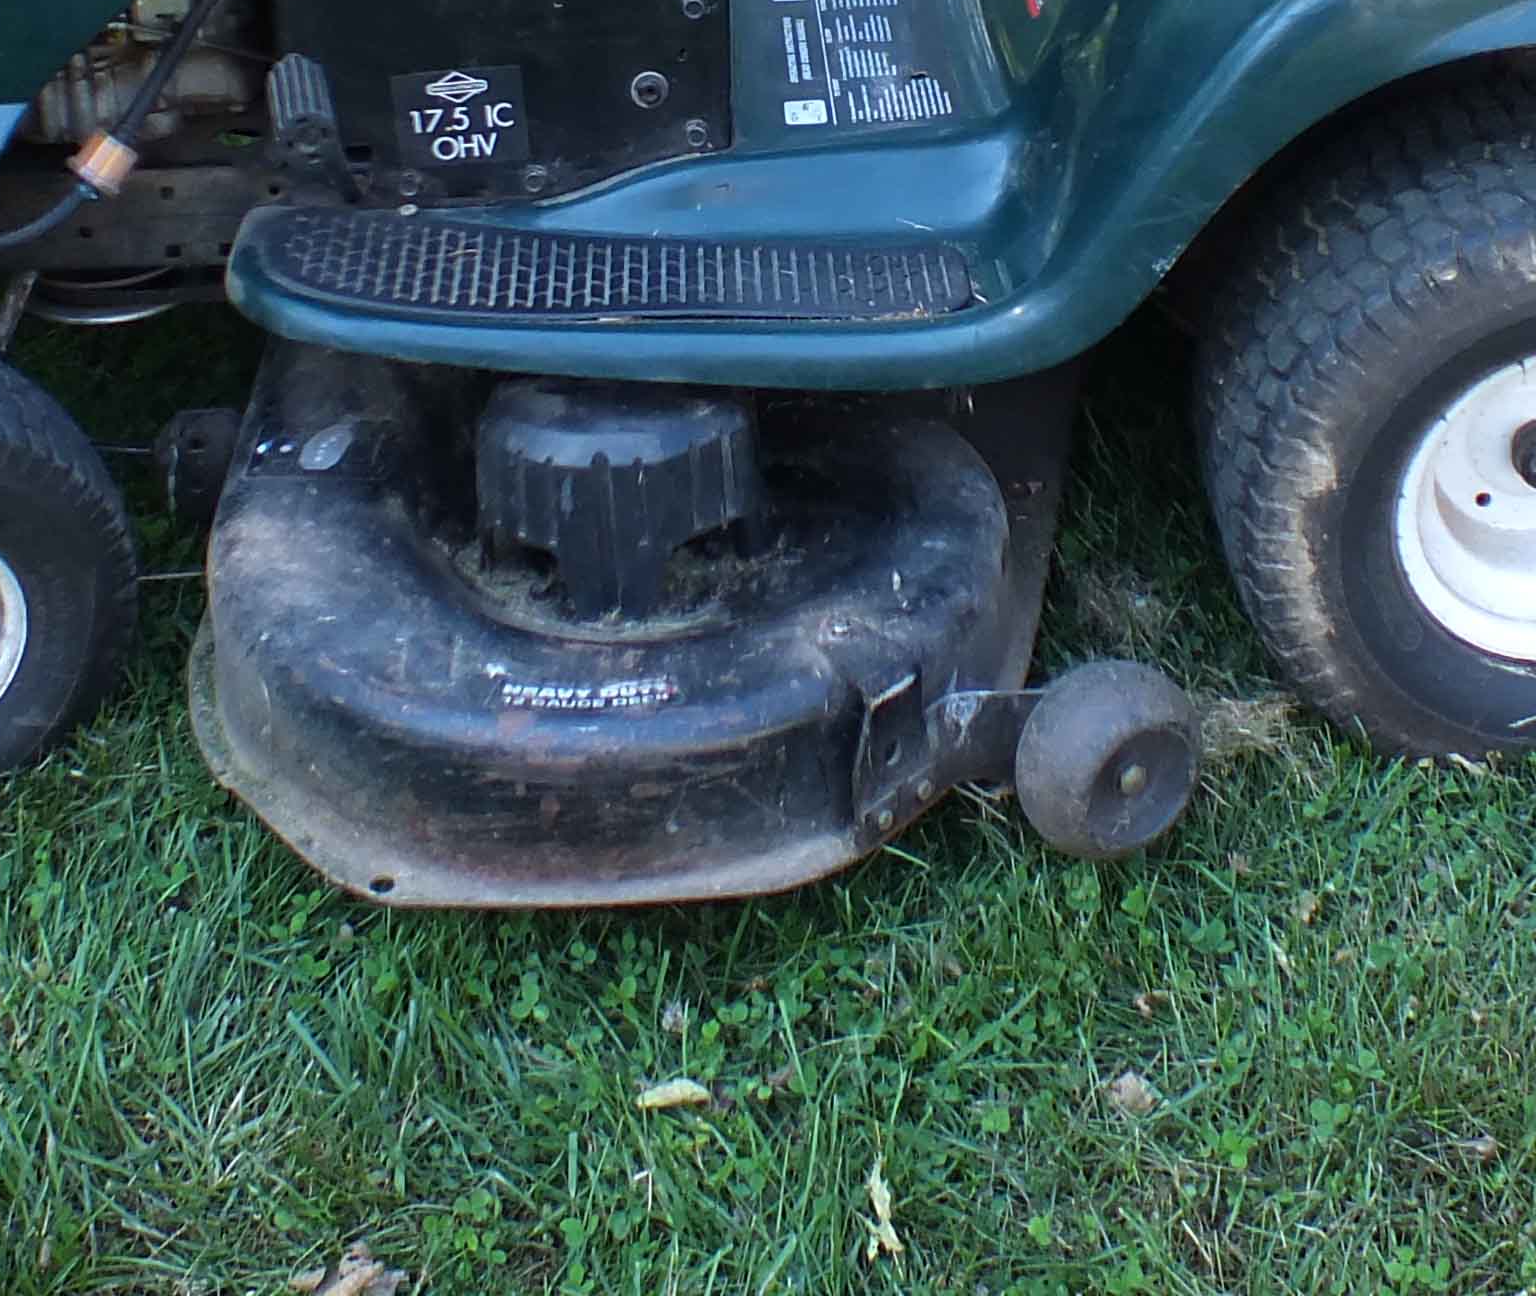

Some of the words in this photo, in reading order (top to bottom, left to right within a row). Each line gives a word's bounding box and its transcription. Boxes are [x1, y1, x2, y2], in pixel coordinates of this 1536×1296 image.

[484, 102, 515, 128] IC
[432, 132, 498, 160] OHV
[502, 683, 593, 699] HEAVY
